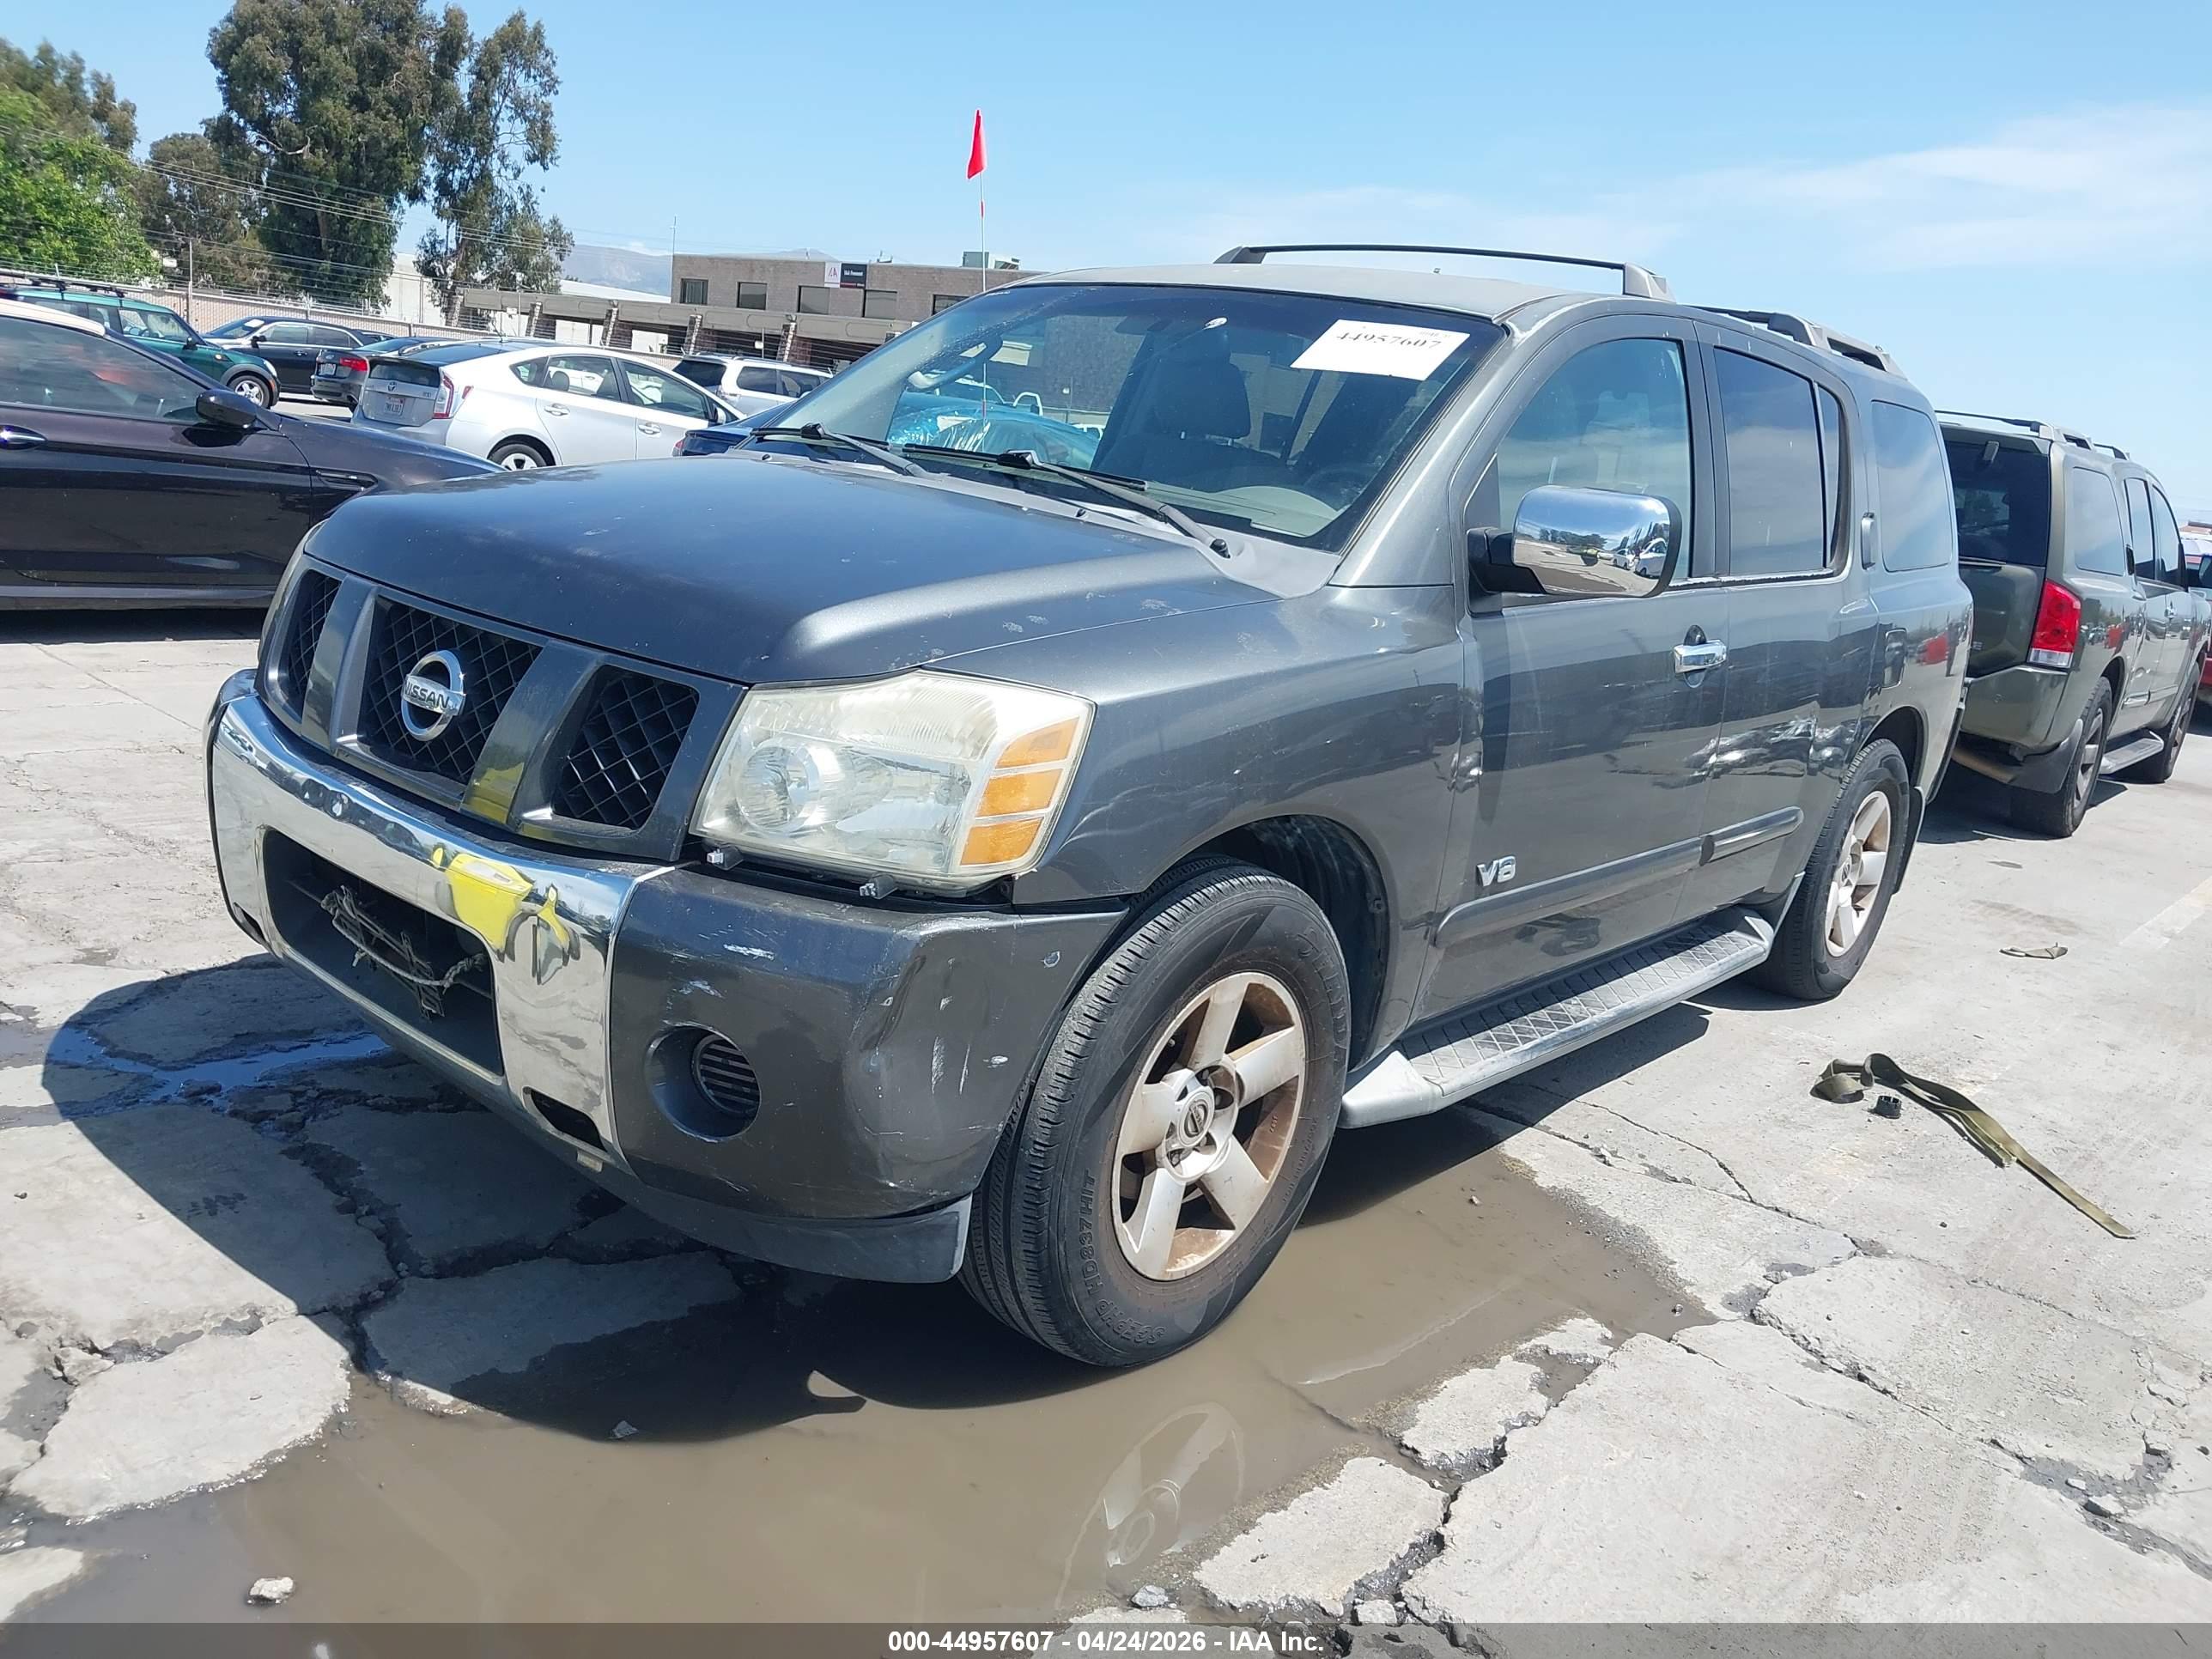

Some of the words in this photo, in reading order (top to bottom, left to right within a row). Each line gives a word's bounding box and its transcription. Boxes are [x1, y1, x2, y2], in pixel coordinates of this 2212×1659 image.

[1335, 331, 1443, 349] 44957607
[404, 680, 449, 709] NISSAN
[1477, 855, 1516, 886] V8
